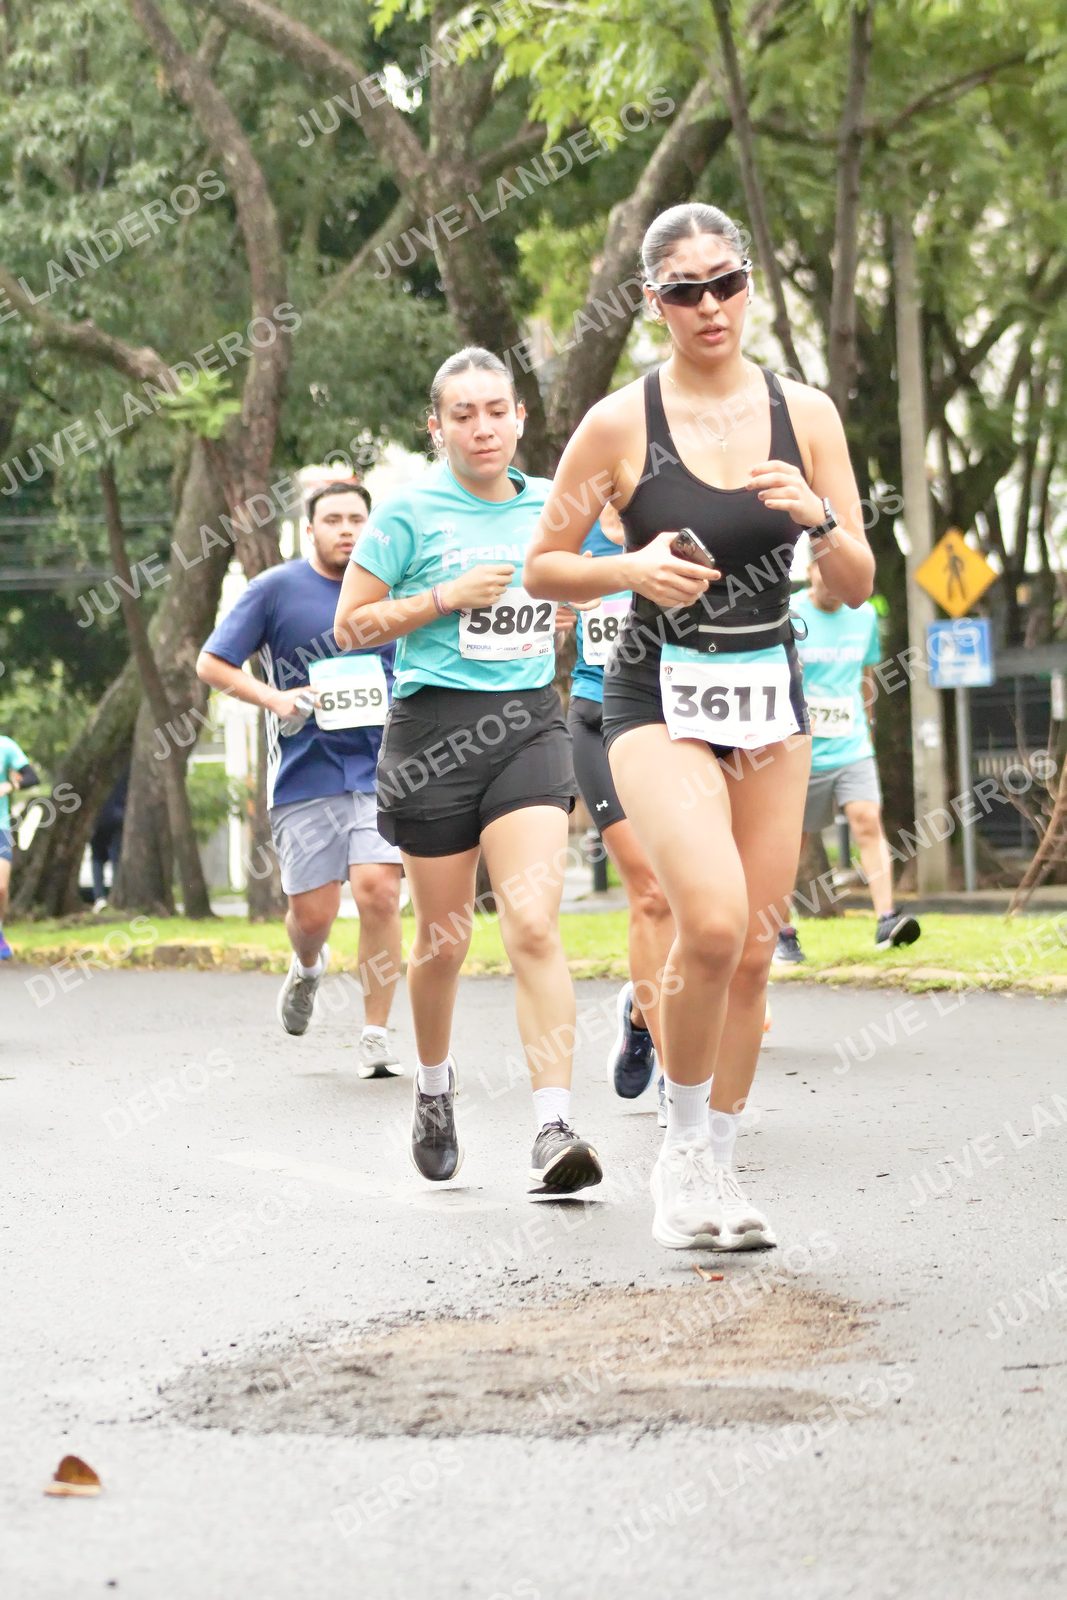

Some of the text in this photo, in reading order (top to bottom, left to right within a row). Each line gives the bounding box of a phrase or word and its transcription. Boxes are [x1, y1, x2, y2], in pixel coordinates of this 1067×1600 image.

[467, 603, 552, 635] 5802
[587, 616, 625, 643] 68
[320, 688, 383, 711] 6559
[671, 685, 776, 721] 3611
